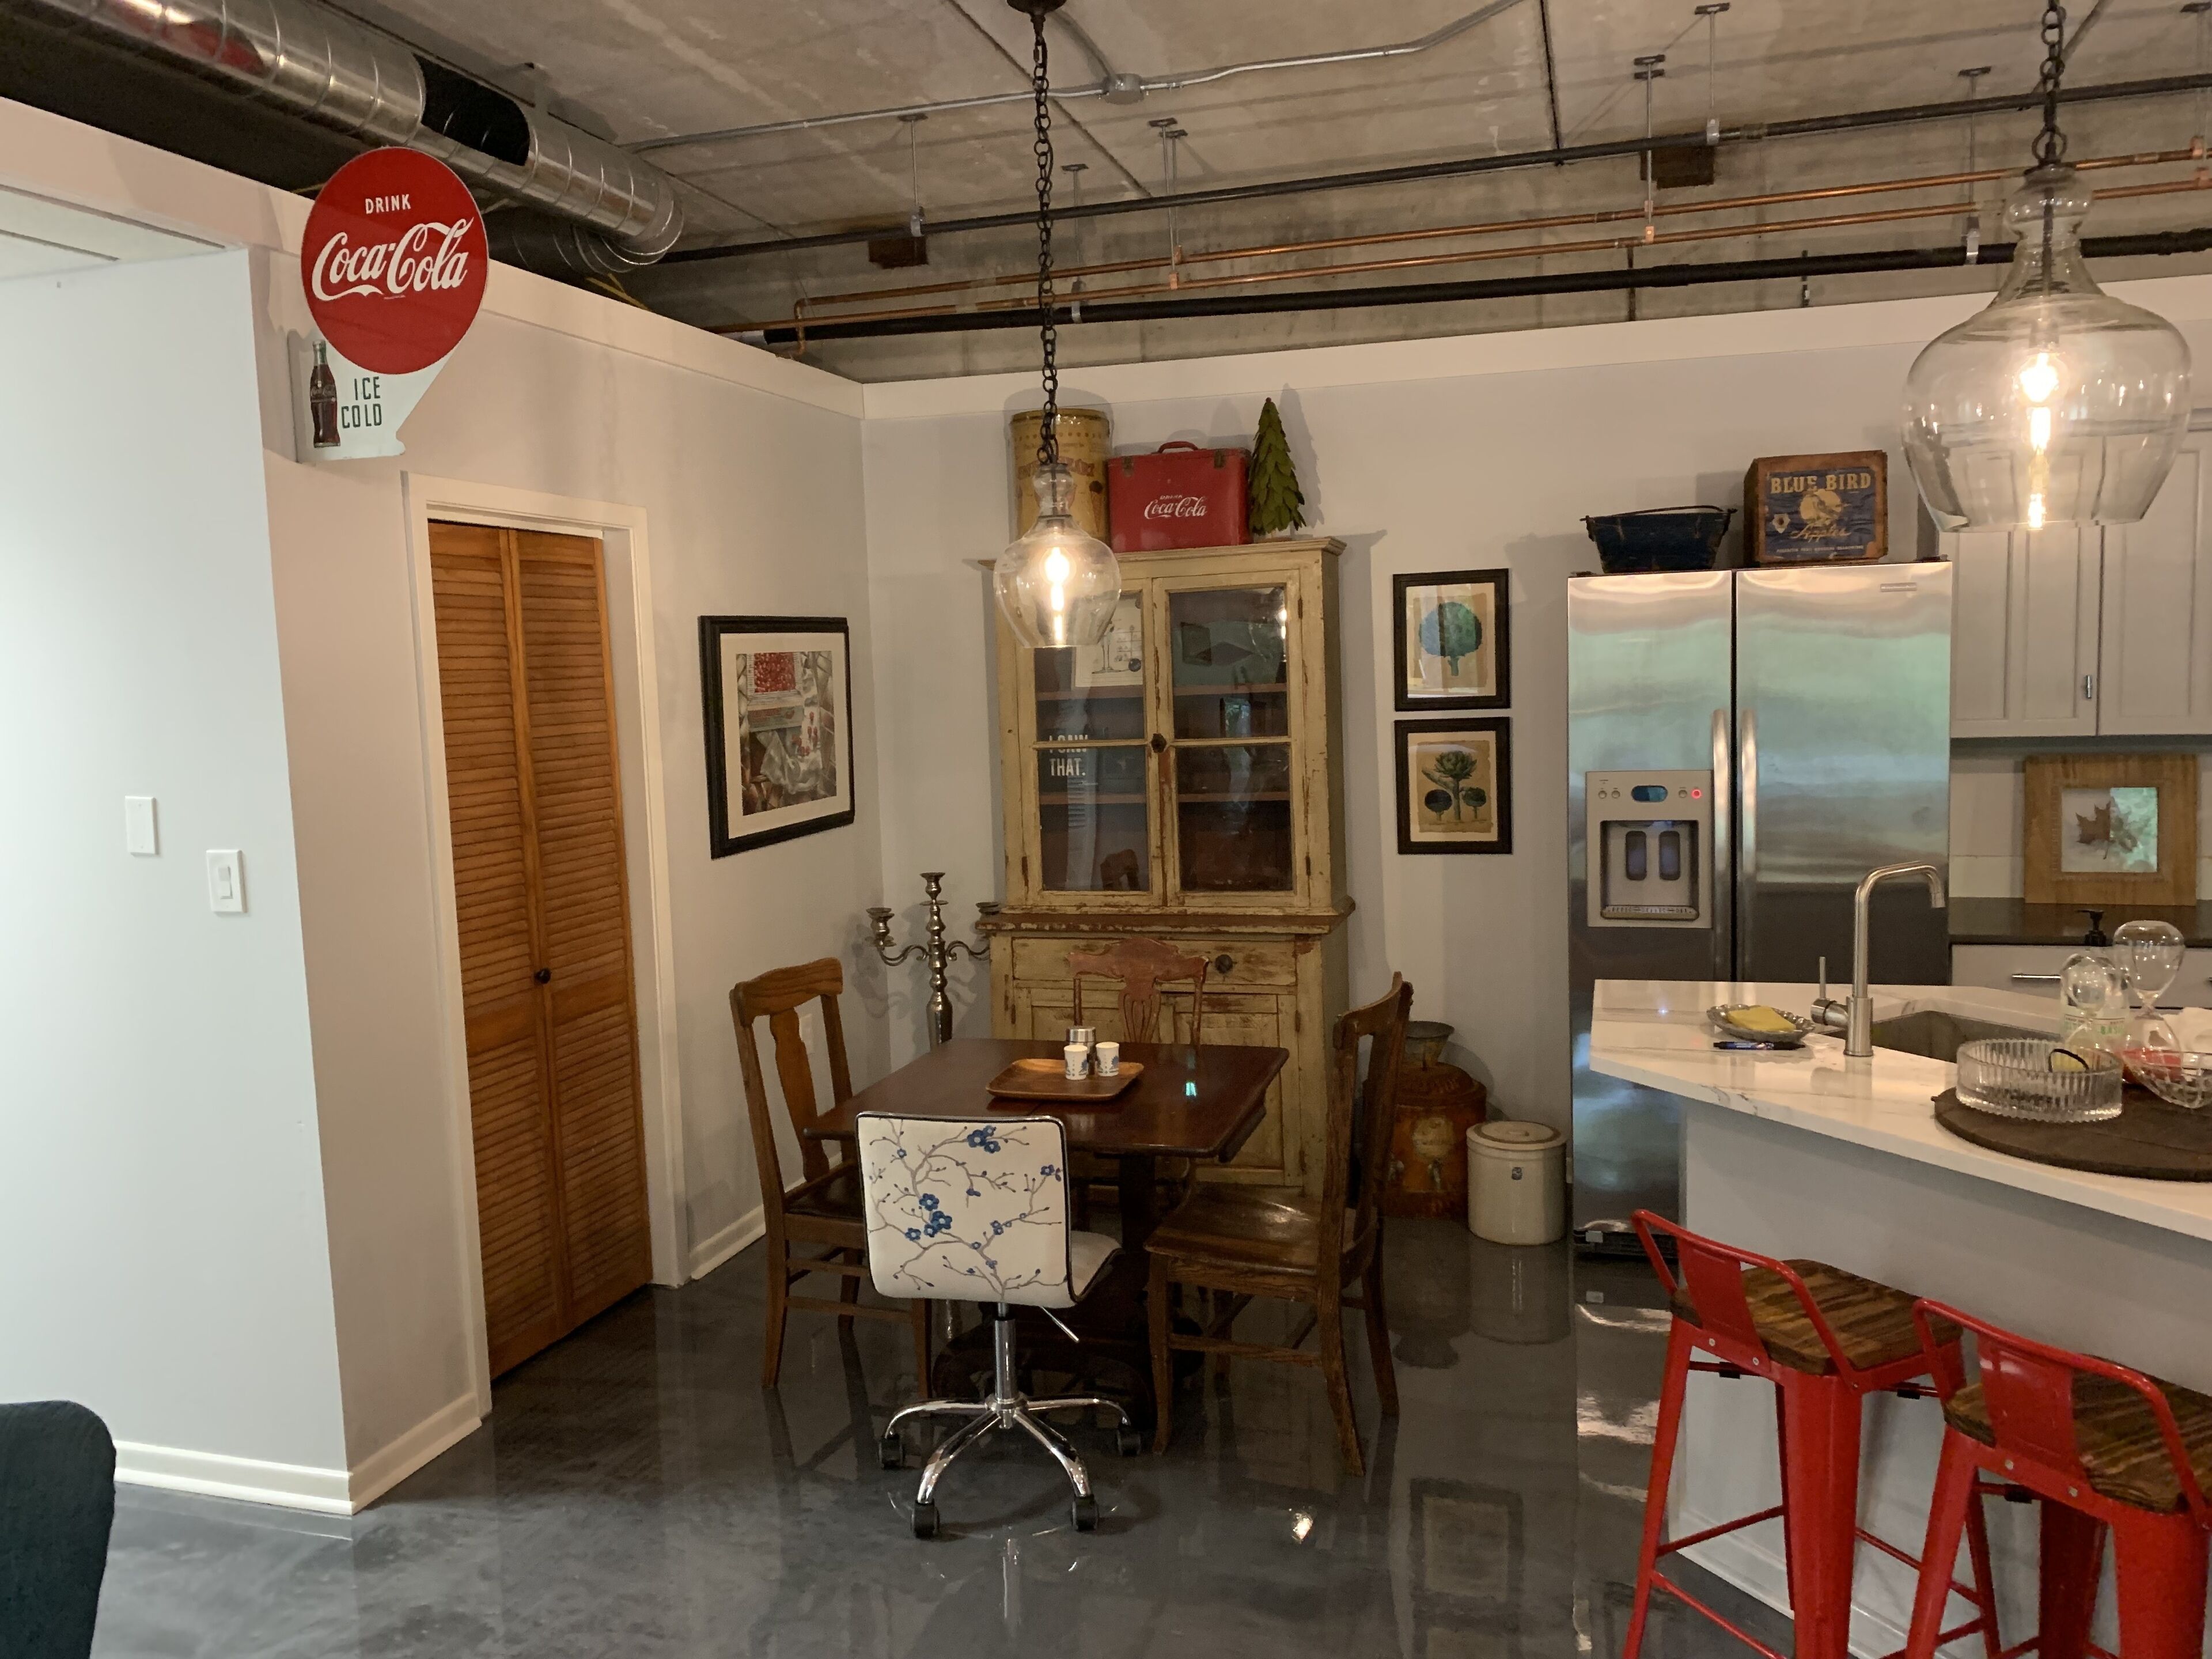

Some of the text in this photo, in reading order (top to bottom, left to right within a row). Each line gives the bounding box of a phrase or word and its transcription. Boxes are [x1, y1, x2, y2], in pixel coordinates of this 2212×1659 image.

[365, 194, 411, 214] DRINK
[312, 217, 474, 301] Coca-Cola
[354, 376, 381, 400] ICE
[341, 403, 382, 429] COLD
[1770, 472, 1872, 494] BLUE BIRD
[1144, 496, 1207, 520] Coca-Cola
[1050, 757, 1086, 777] THAT.
